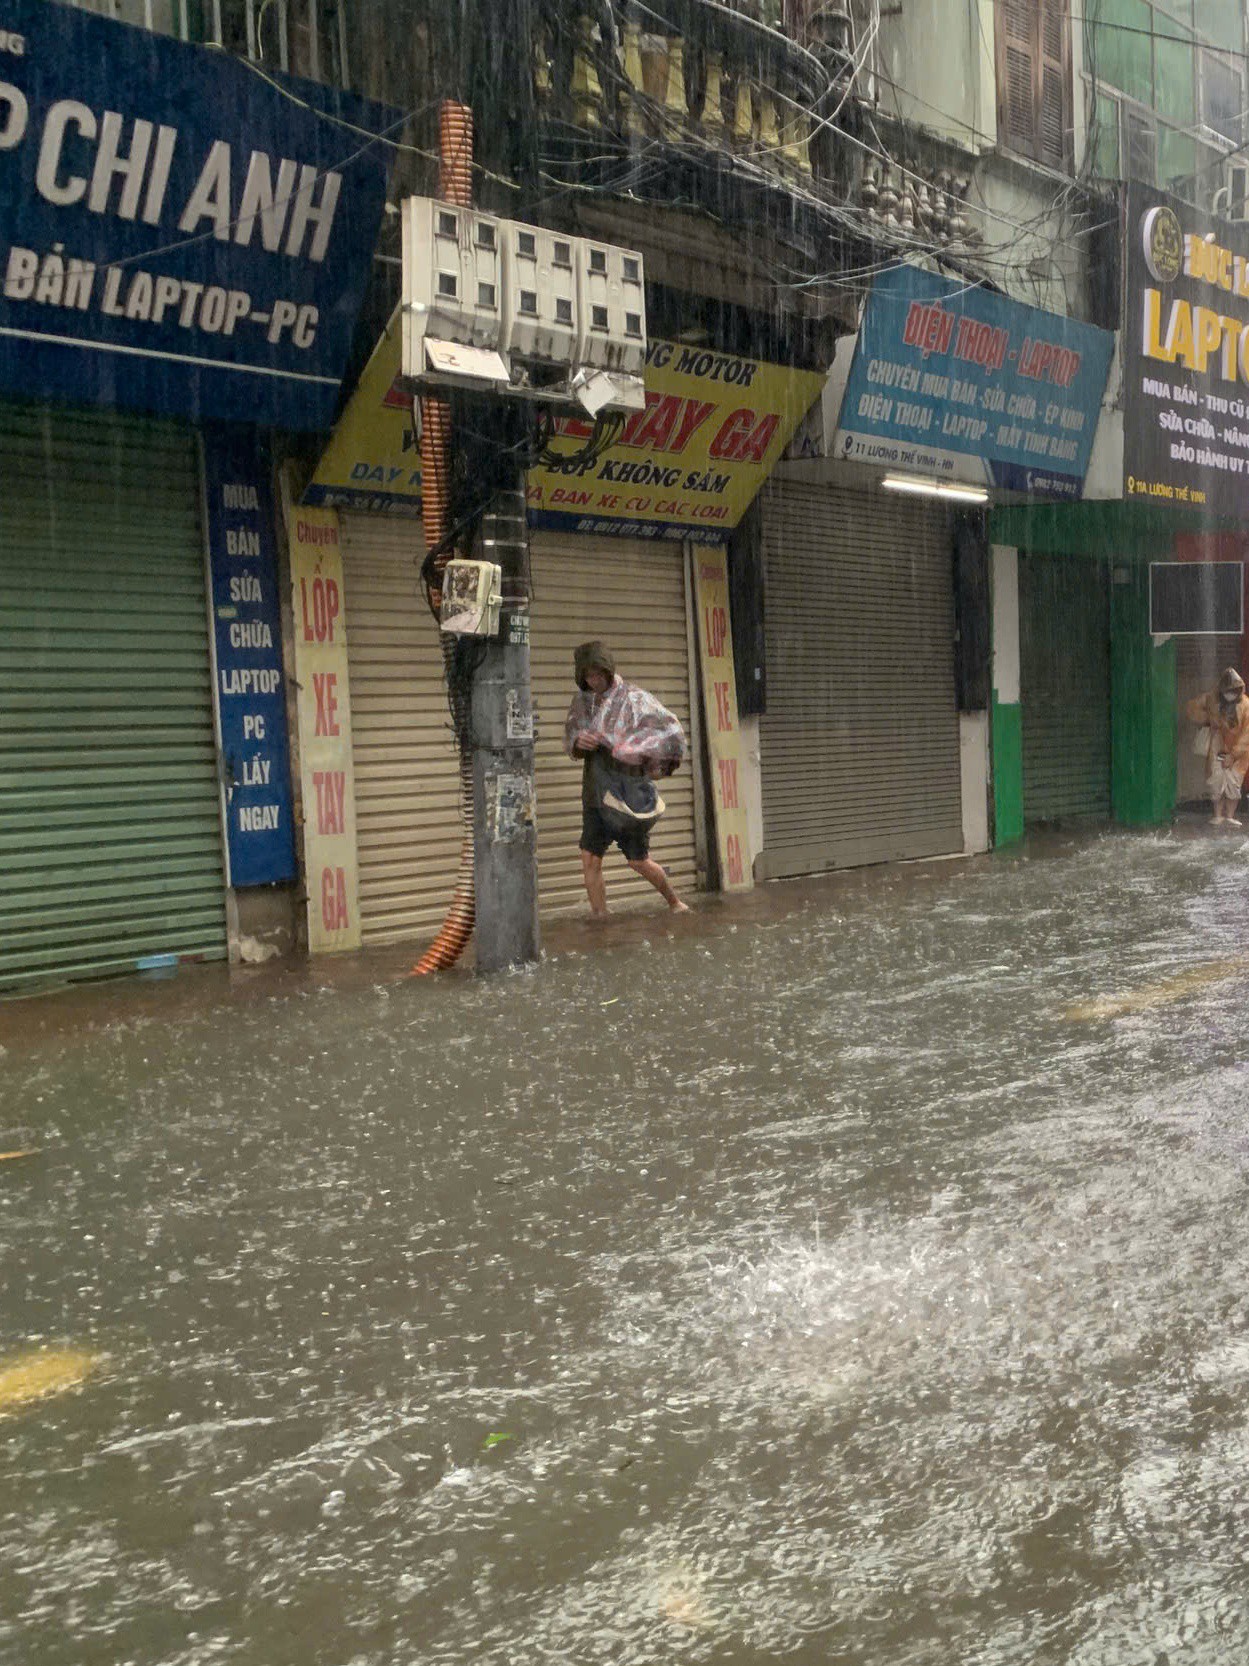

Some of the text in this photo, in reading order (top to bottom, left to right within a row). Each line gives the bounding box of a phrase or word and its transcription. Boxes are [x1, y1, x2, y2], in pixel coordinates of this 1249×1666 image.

[36, 99, 178, 226] CHI
[177, 138, 344, 263] ANH
[4, 243, 320, 349] BÁN LAPTOP-PC
[903, 300, 1082, 388] ĐIỆN THOẠI LAPTOP
[673, 348, 758, 387] MOTOR
[867, 359, 921, 390] CHUYÊN
[921, 373, 950, 399] MUA
[950, 378, 978, 405] BÁN
[1142, 377, 1171, 400] MUA
[1173, 383, 1198, 406] BÁN
[1205, 394, 1228, 415] THU
[1229, 398, 1244, 418] CŨ
[857, 392, 893, 427] ĐIỆN
[894, 401, 934, 434] THOẠI
[942, 411, 988, 442] LAPTOP
[1159, 409, 1184, 433] SỬA
[1183, 418, 1215, 440] CHỮA
[708, 407, 784, 465] GA
[597, 459, 682, 487] KHÔNG
[855, 442, 866, 455] 11
[867, 444, 899, 463] LƯƠNG
[916, 453, 936, 469] VINH
[1170, 440, 1196, 464] BẢO
[1196, 446, 1228, 470] HÀNH
[1229, 456, 1245, 473] UY
[223, 483, 260, 511] MUA
[226, 524, 261, 556] BÁN
[229, 569, 263, 603] SỬA
[229, 618, 274, 649] CHỮA
[221, 669, 281, 695] LAPTOP
[312, 672, 341, 738] XE
[714, 682, 733, 732] XE
[243, 714, 267, 740] PC
[243, 751, 272, 786] LẤY
[239, 804, 281, 832] NGAY
[313, 771, 346, 836] TAY
[321, 866, 349, 932] GA
